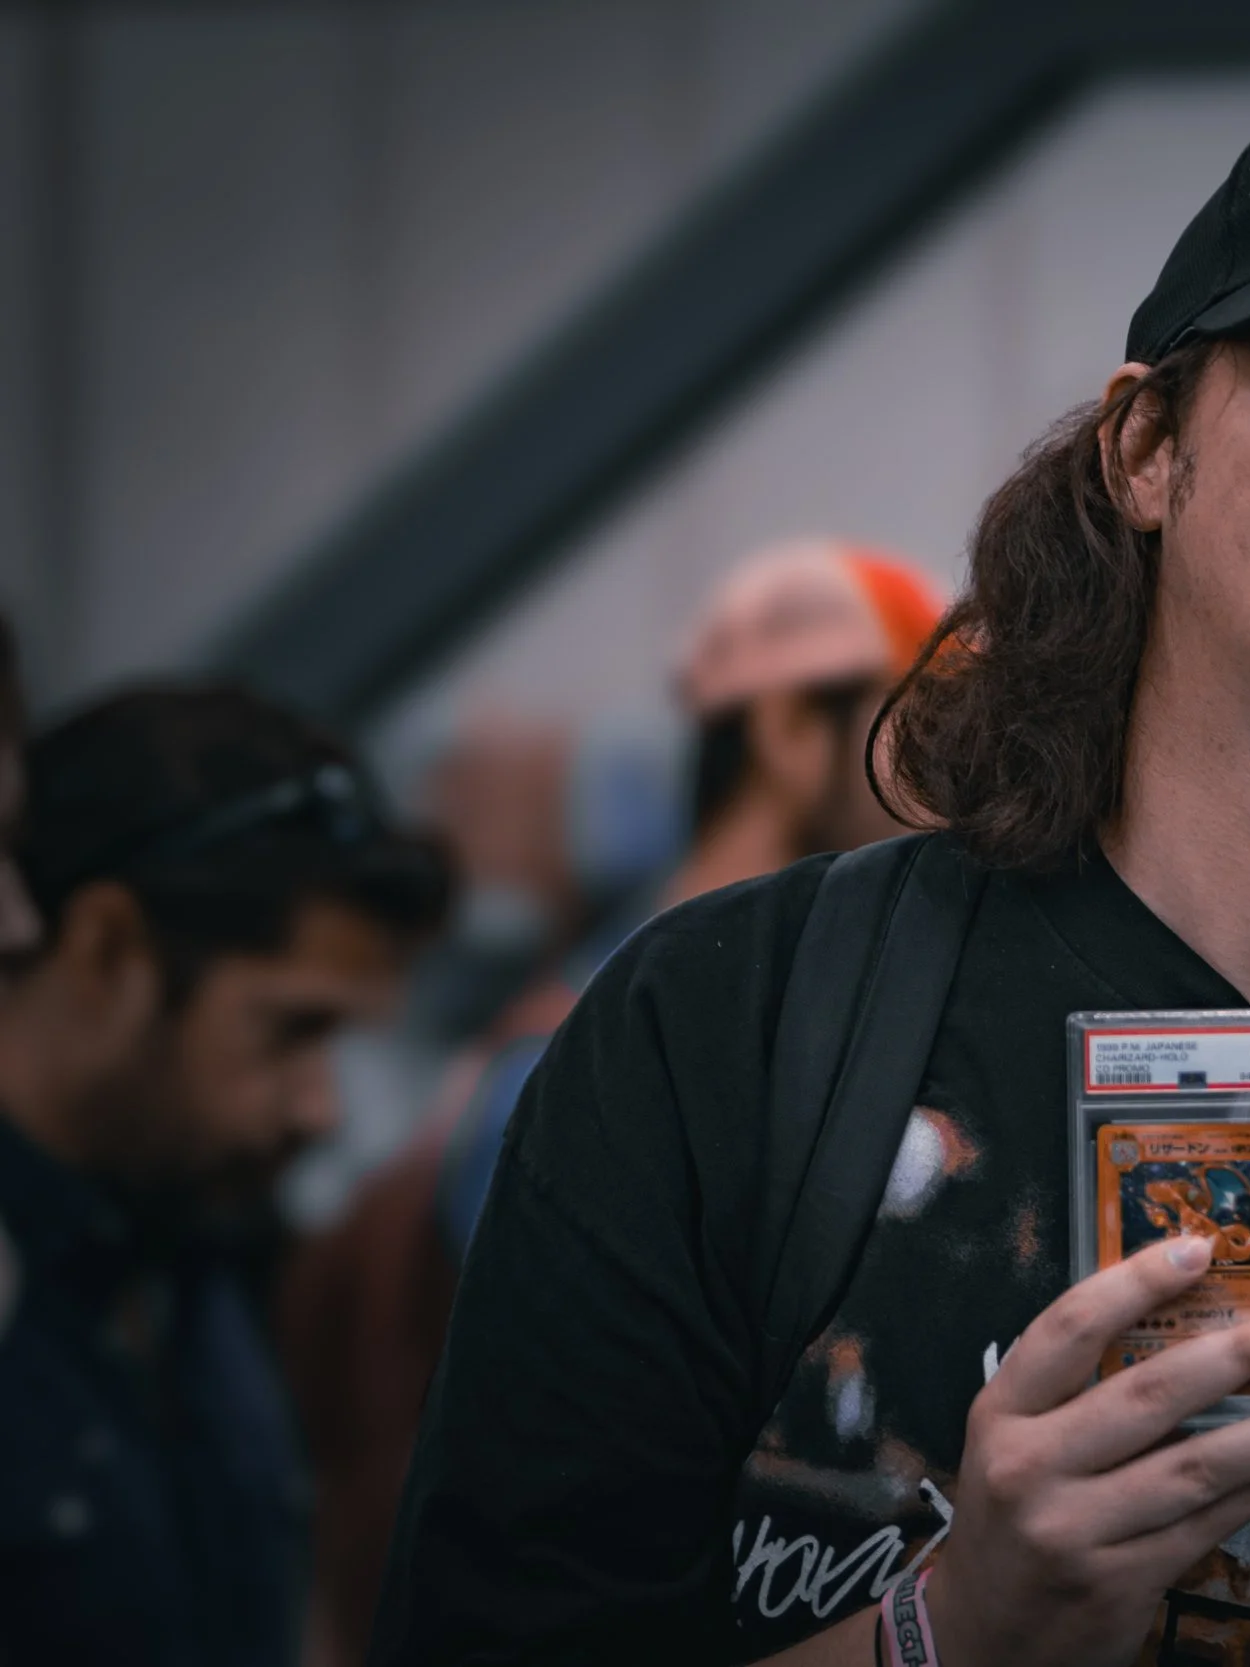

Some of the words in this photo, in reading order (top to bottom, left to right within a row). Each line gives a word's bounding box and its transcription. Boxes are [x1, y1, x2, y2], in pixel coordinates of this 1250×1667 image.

[1145, 1041, 1199, 1051] JAPANESE
[1095, 1051, 1190, 1063] CHARIZARD-HOLO
[1095, 1064, 1111, 1074] CD
[1112, 1063, 1151, 1074] PROMO
[1150, 1141, 1211, 1155] リザードン
